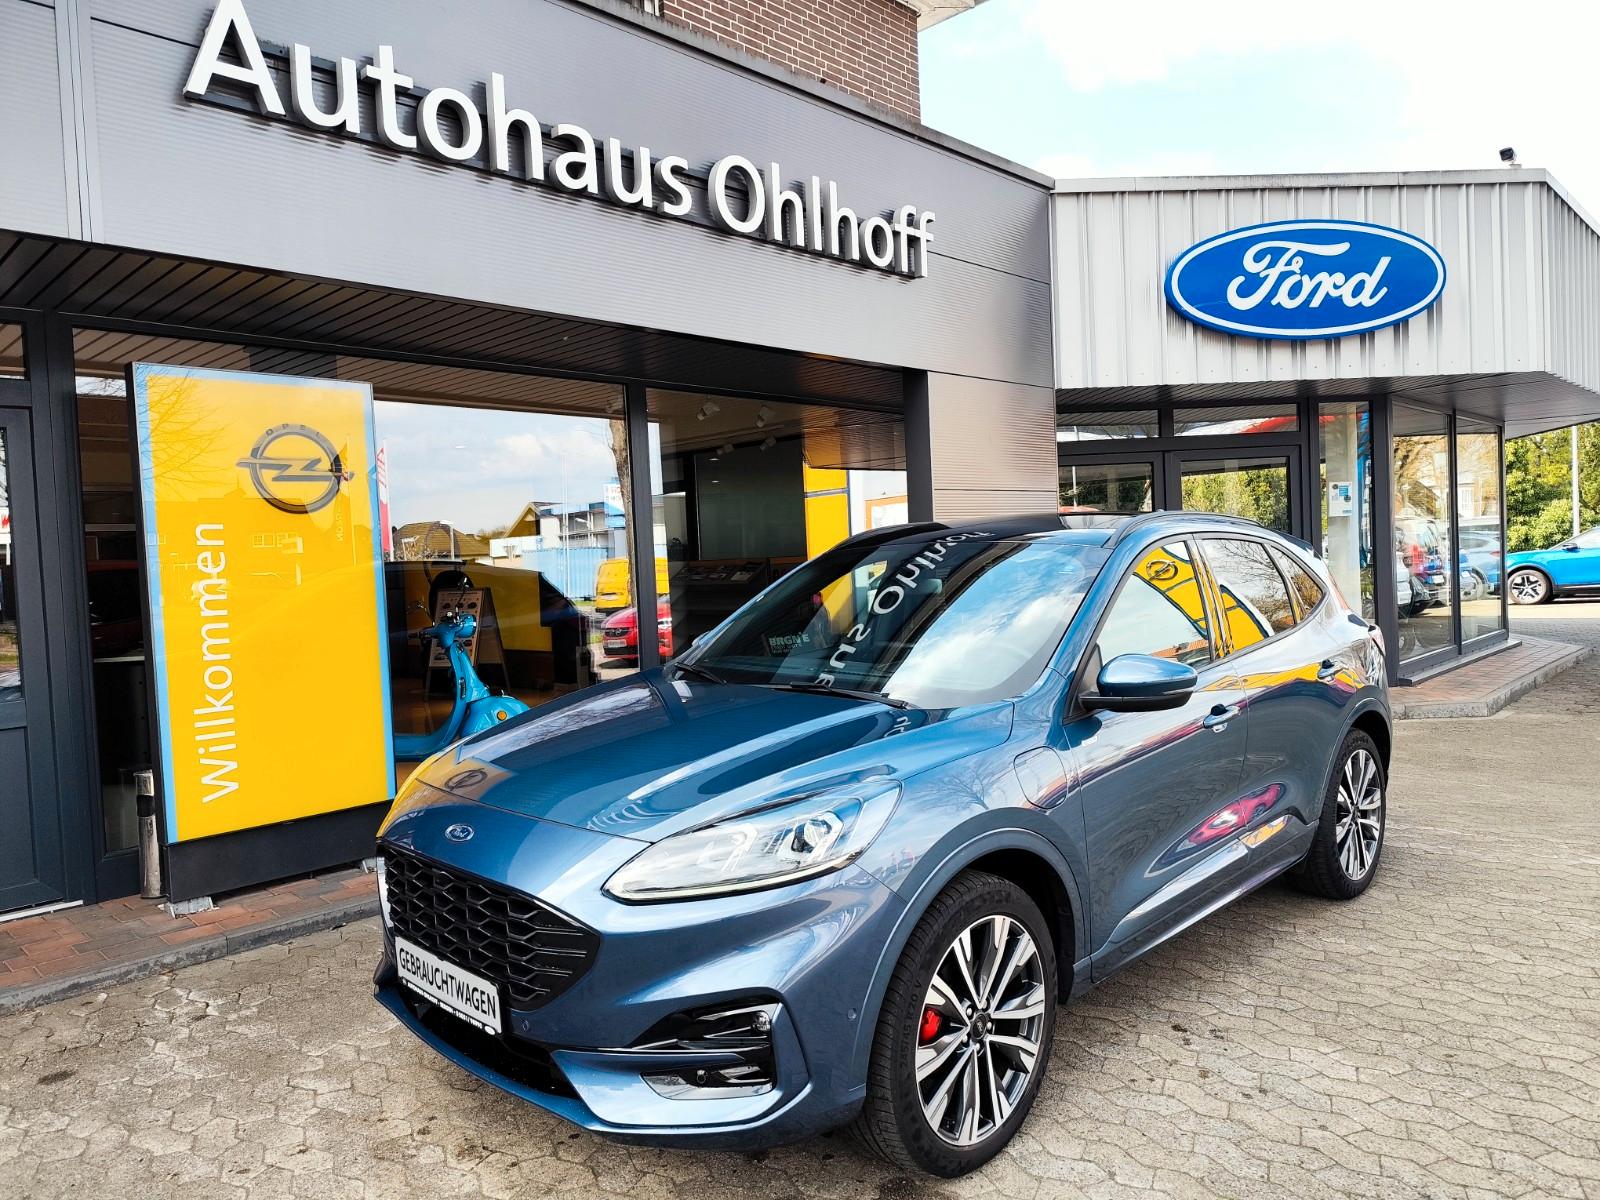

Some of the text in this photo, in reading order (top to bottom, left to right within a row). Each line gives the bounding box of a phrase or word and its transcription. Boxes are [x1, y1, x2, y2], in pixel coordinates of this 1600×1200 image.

[183, 0, 935, 277] Autohaus Ohlhoff
[1226, 240, 1391, 310] Ford
[193, 523, 240, 804] Willkommen
[399, 947, 497, 1019] GEBRAUCHTWAGEN
